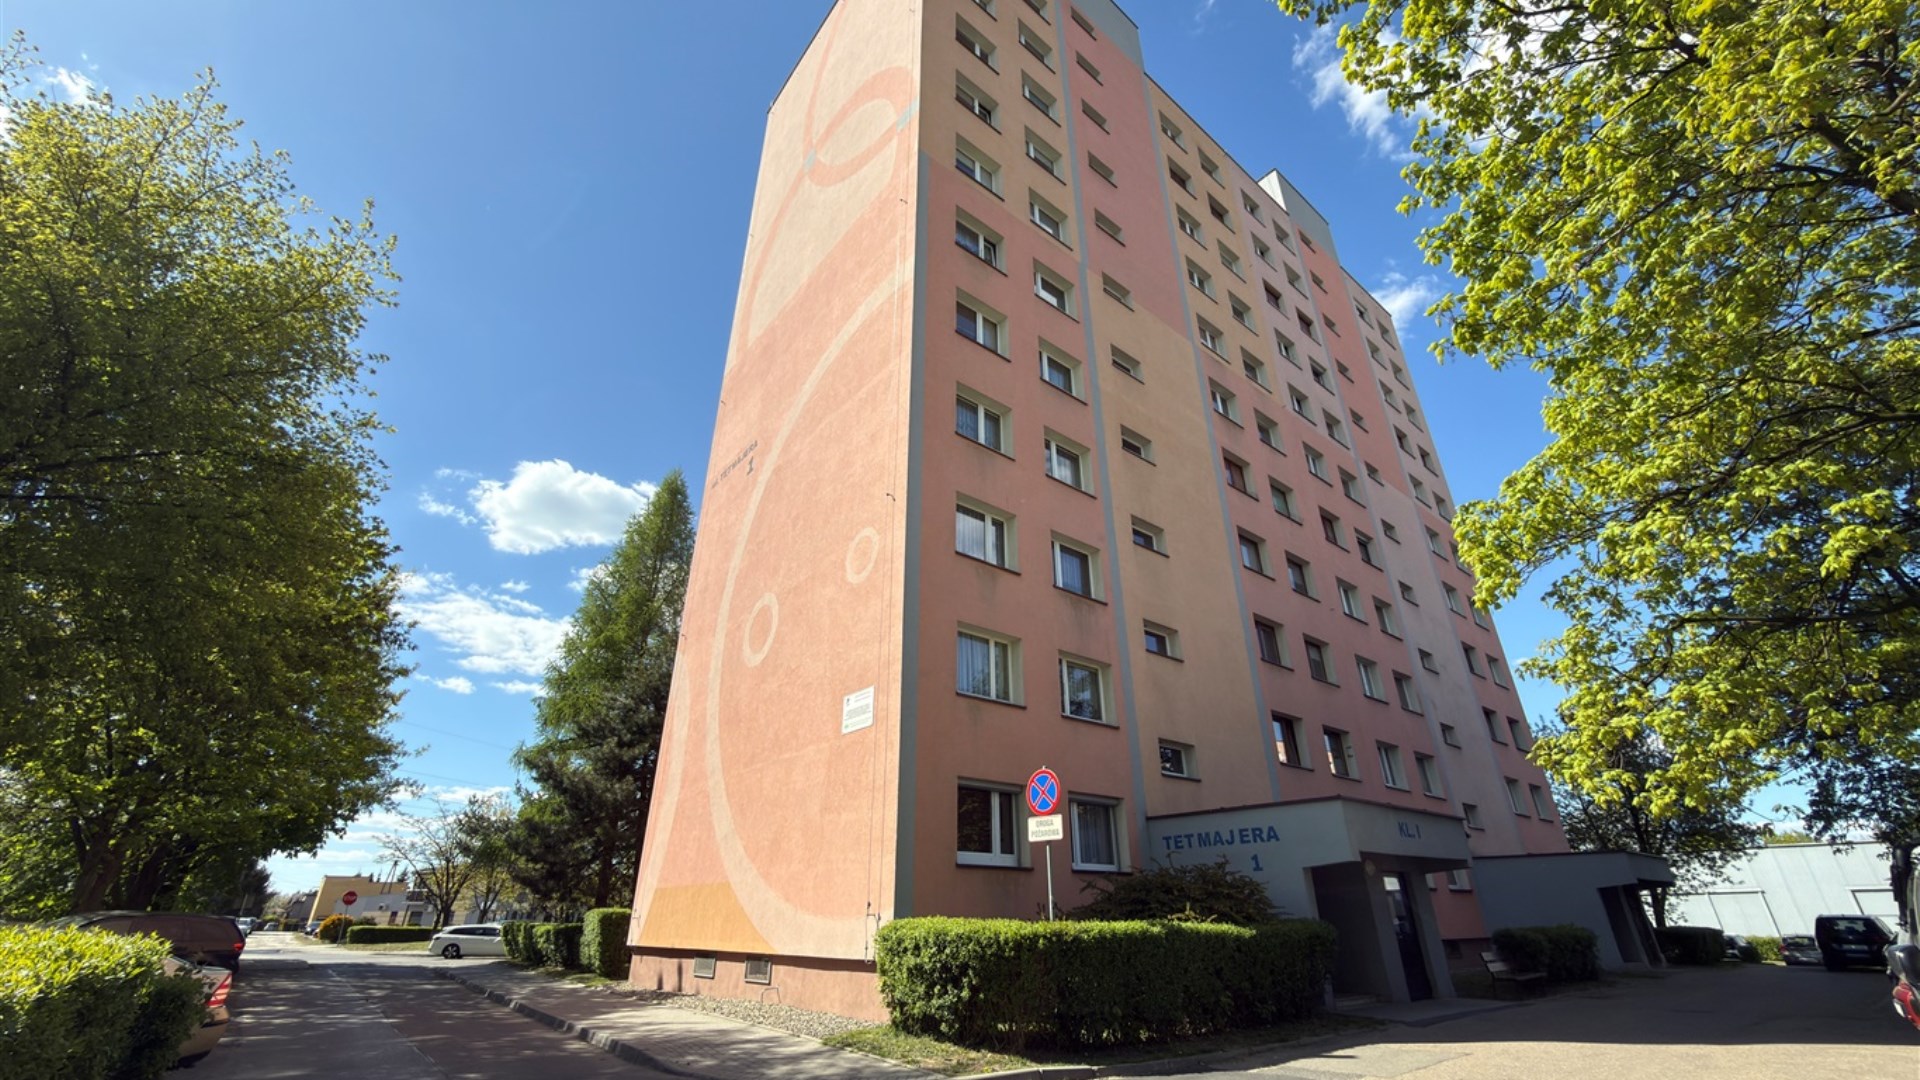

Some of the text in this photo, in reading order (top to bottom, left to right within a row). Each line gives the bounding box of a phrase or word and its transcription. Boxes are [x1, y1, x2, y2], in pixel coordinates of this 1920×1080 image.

[746, 455, 754, 476] 1
[1162, 825, 1280, 850] TETMAJERA
[1250, 853, 1264, 872] 1
